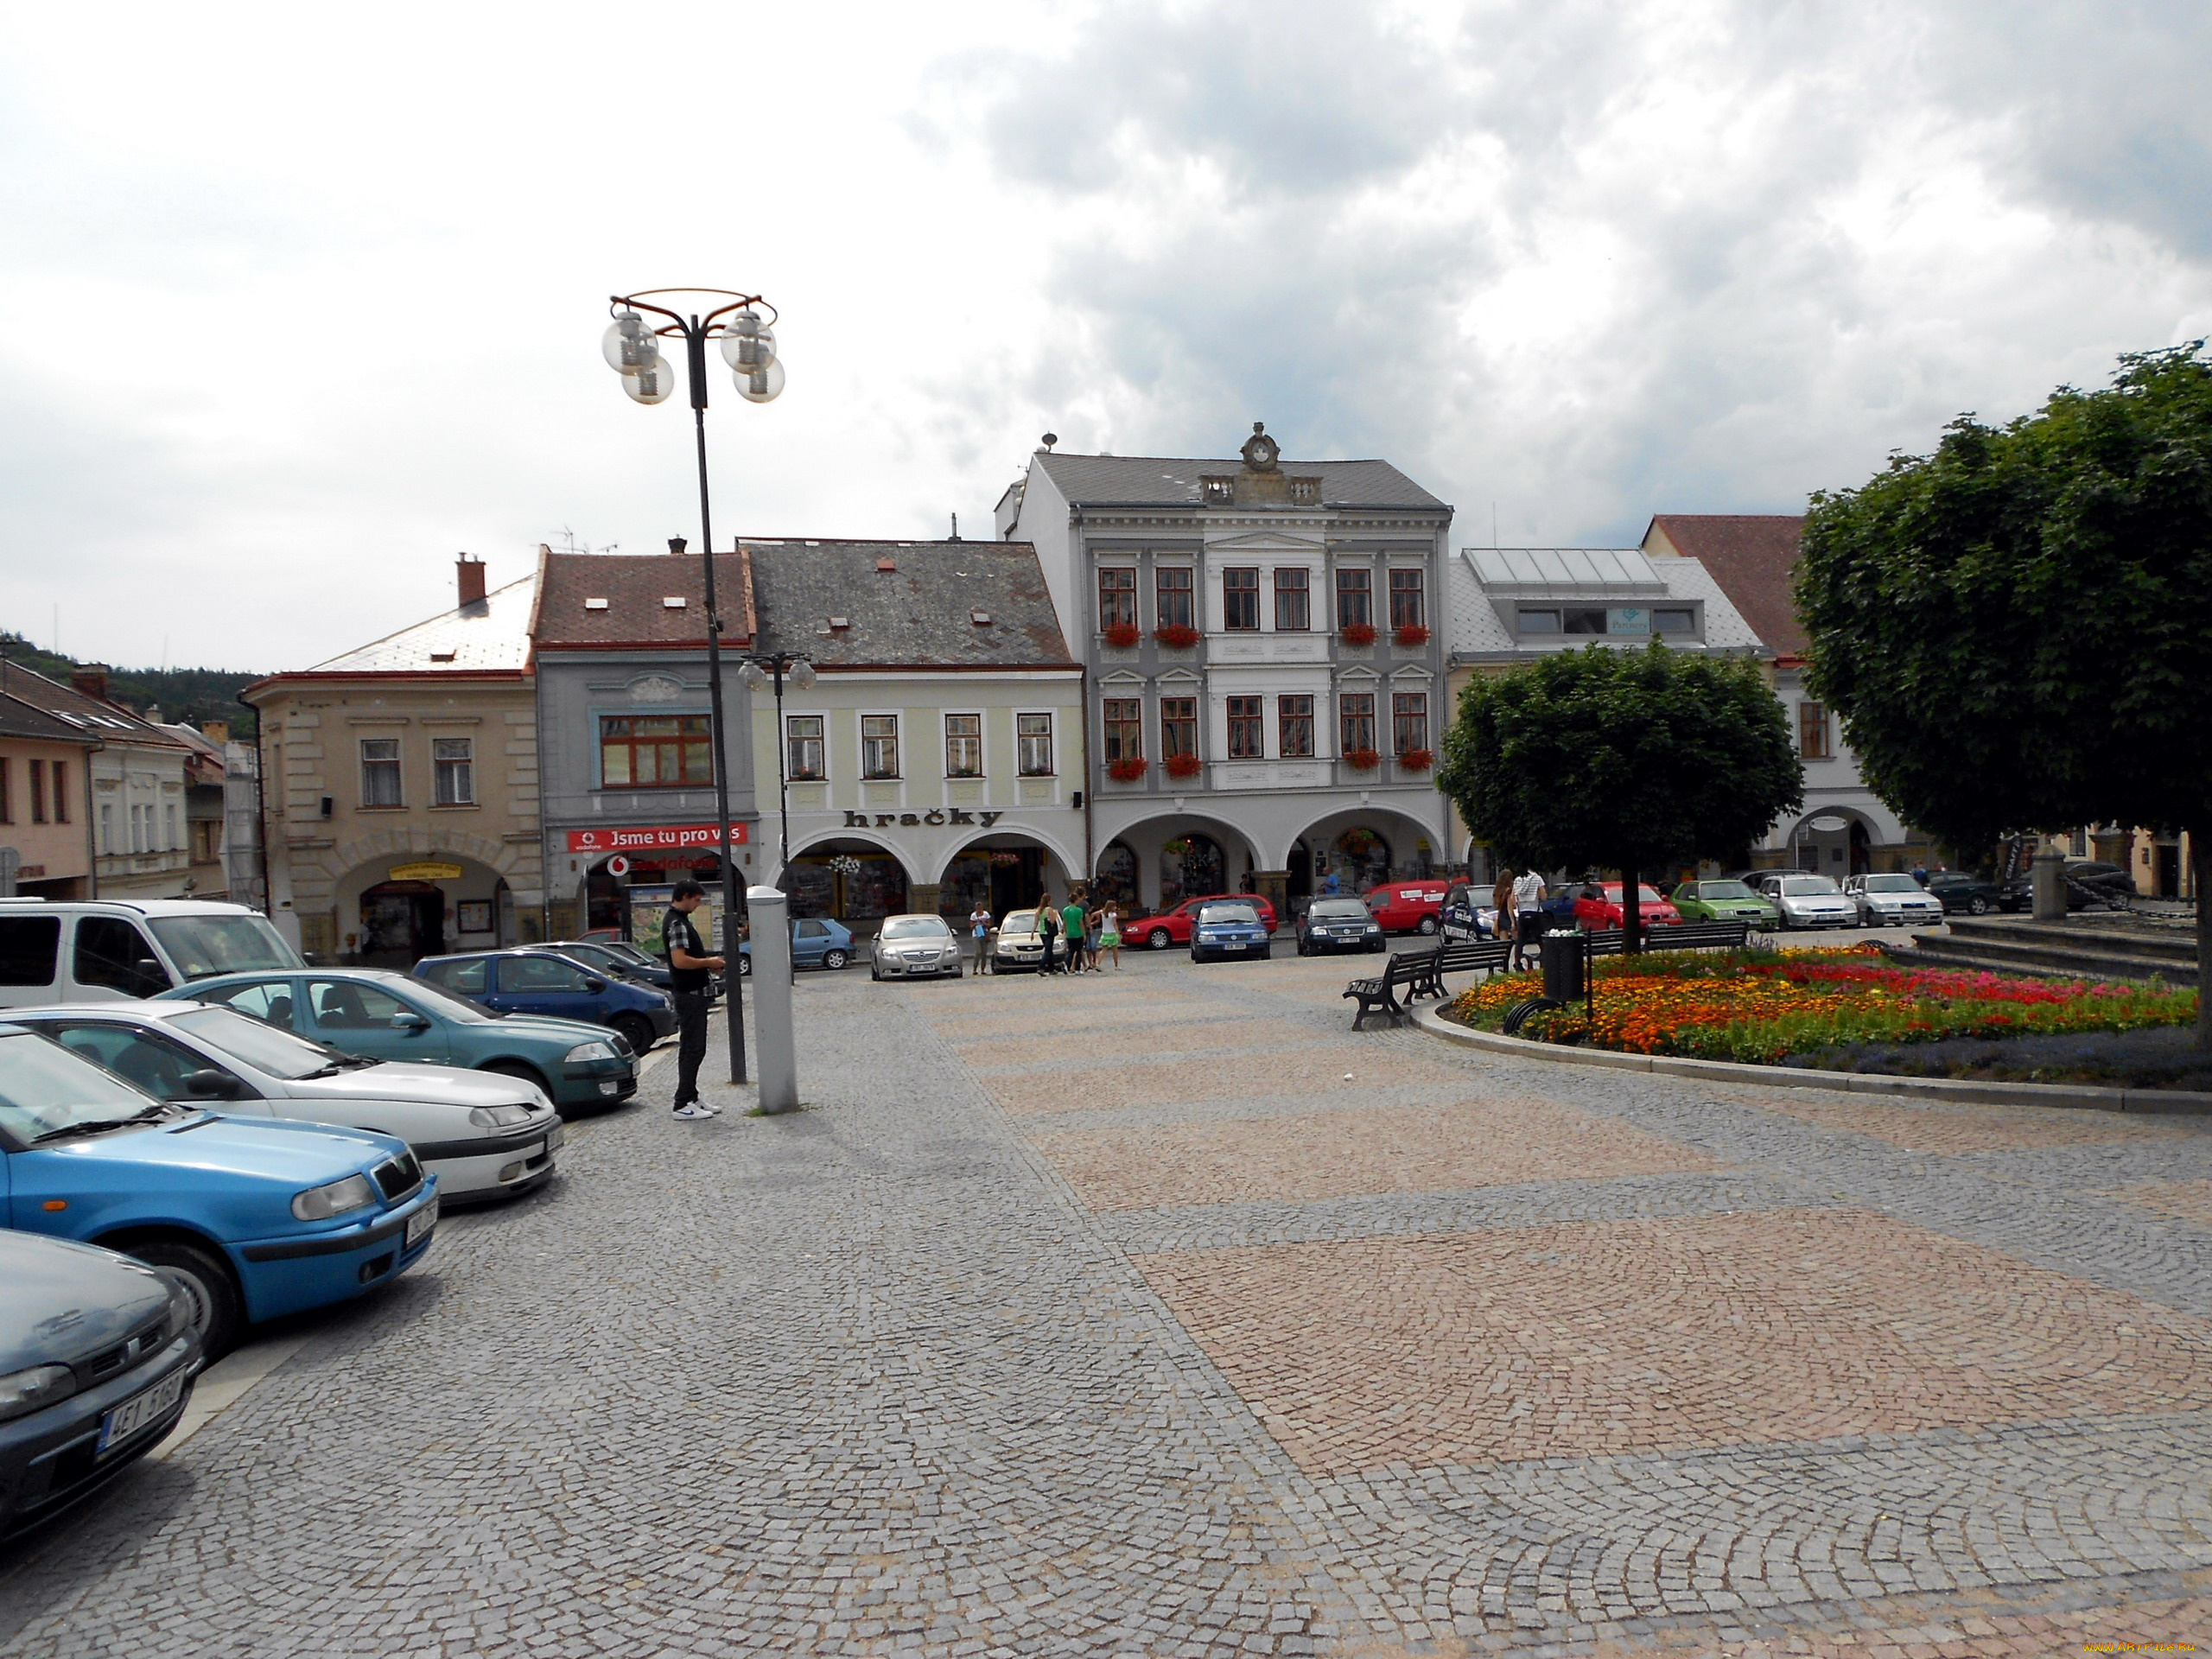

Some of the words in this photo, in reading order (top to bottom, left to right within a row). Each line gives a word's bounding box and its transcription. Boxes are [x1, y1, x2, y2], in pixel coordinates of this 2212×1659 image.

[843, 808, 1004, 829] hračky
[611, 830, 655, 846] Jsme
[658, 830, 676, 843] tu
[680, 829, 708, 846] pro
[711, 827, 741, 841] vs
